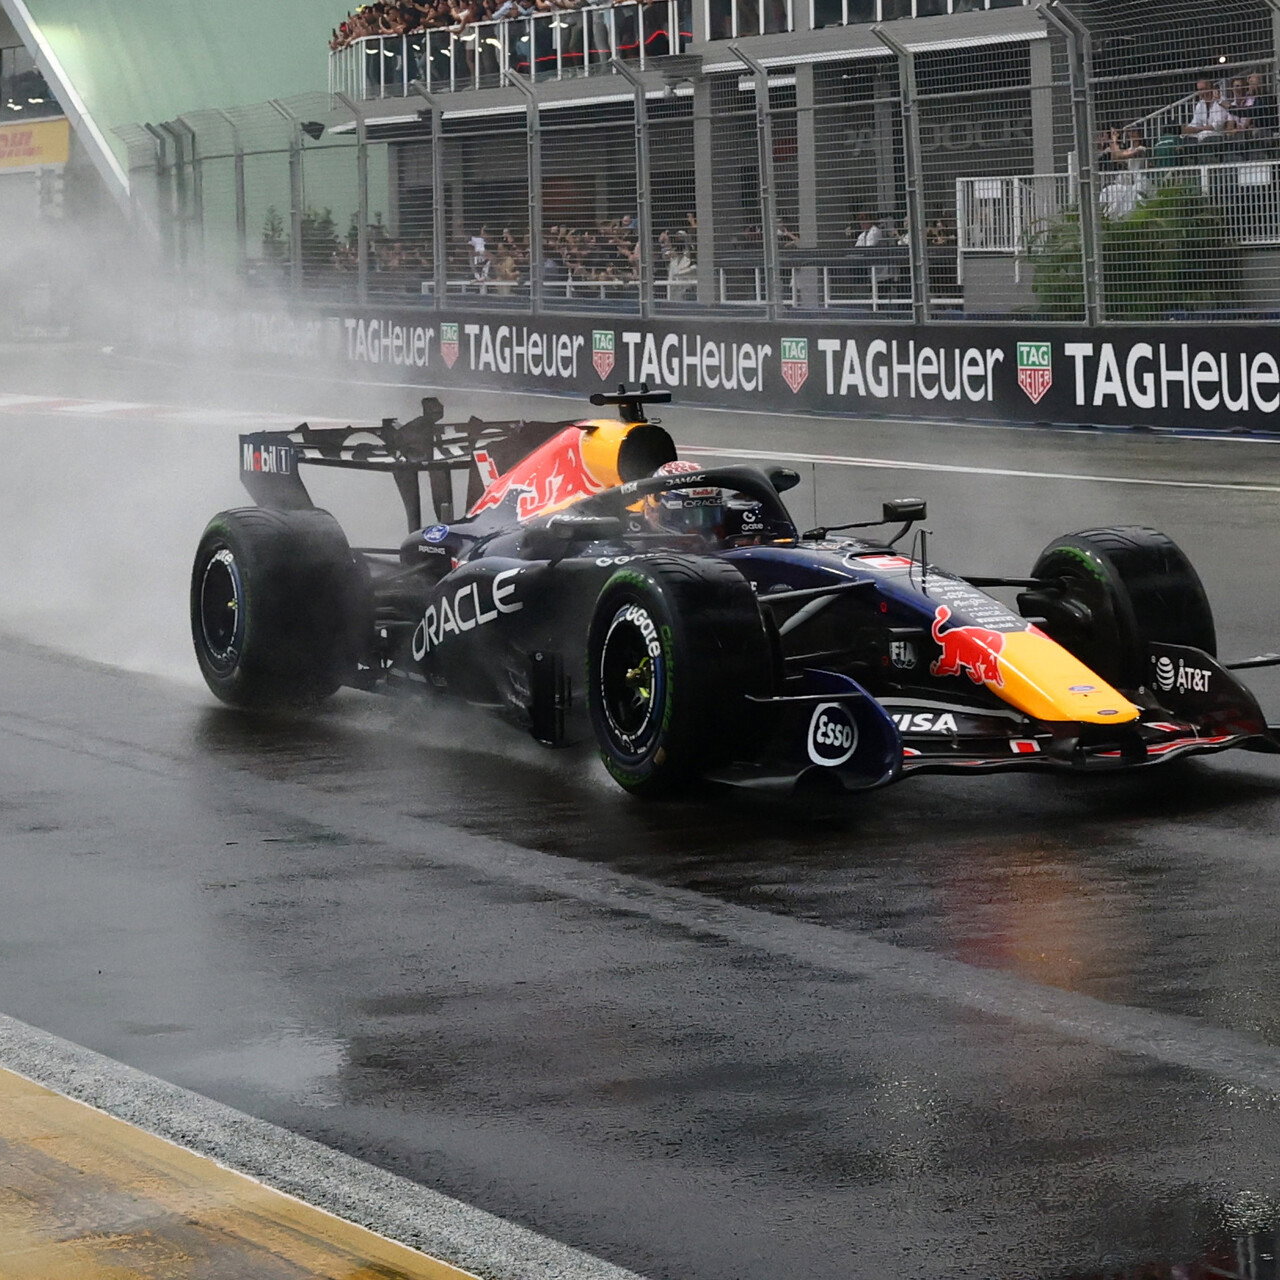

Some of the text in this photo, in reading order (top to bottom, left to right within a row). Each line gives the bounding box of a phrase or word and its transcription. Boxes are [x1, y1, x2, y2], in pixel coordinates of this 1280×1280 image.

[595, 332, 613, 351] TAG
[782, 340, 807, 360] TAG
[1019, 345, 1050, 366] TAG
[781, 362, 808, 391] HEUER
[1018, 368, 1052, 402] HEUER
[243, 443, 277, 473] Mobil
[683, 499, 723, 508] ORACLE
[418, 545, 446, 556] RACING
[412, 568, 525, 663] ORACLE
[1176, 666, 1212, 693] AT&T
